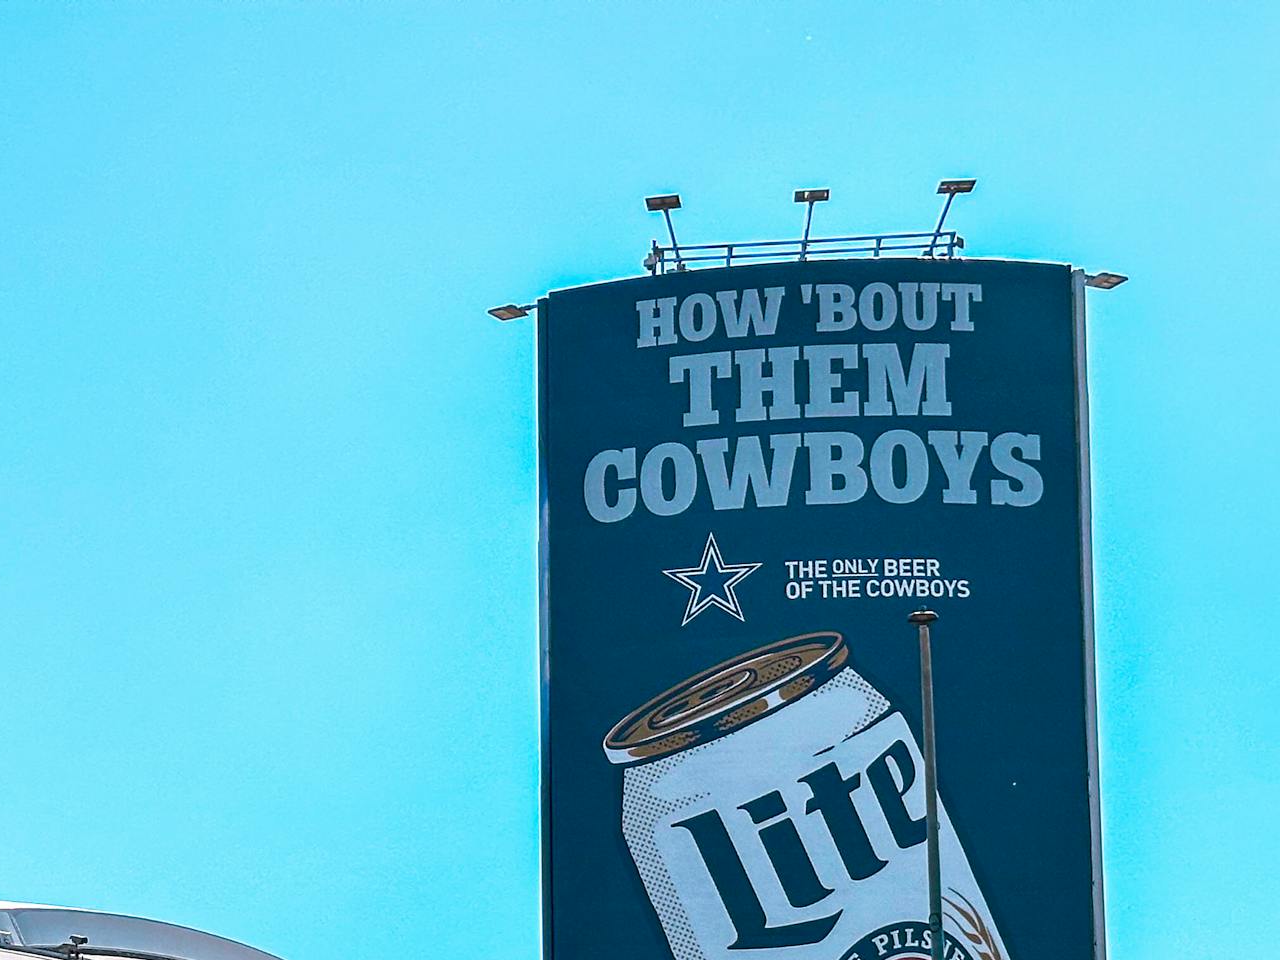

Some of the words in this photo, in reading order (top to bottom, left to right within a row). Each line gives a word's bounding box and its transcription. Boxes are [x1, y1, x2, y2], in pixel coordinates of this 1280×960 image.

[636, 286, 785, 348] HOW
[800, 282, 983, 333] 'BOUT
[669, 342, 952, 427] THEM
[584, 429, 1044, 523] COWBOYS
[785, 560, 828, 579] THE
[832, 559, 879, 575] ONLY
[884, 558, 941, 577] BEER
[785, 580, 814, 600] OF
[818, 580, 861, 598] THE
[866, 579, 971, 598] COWBOYS
[670, 739, 928, 950] Lite
